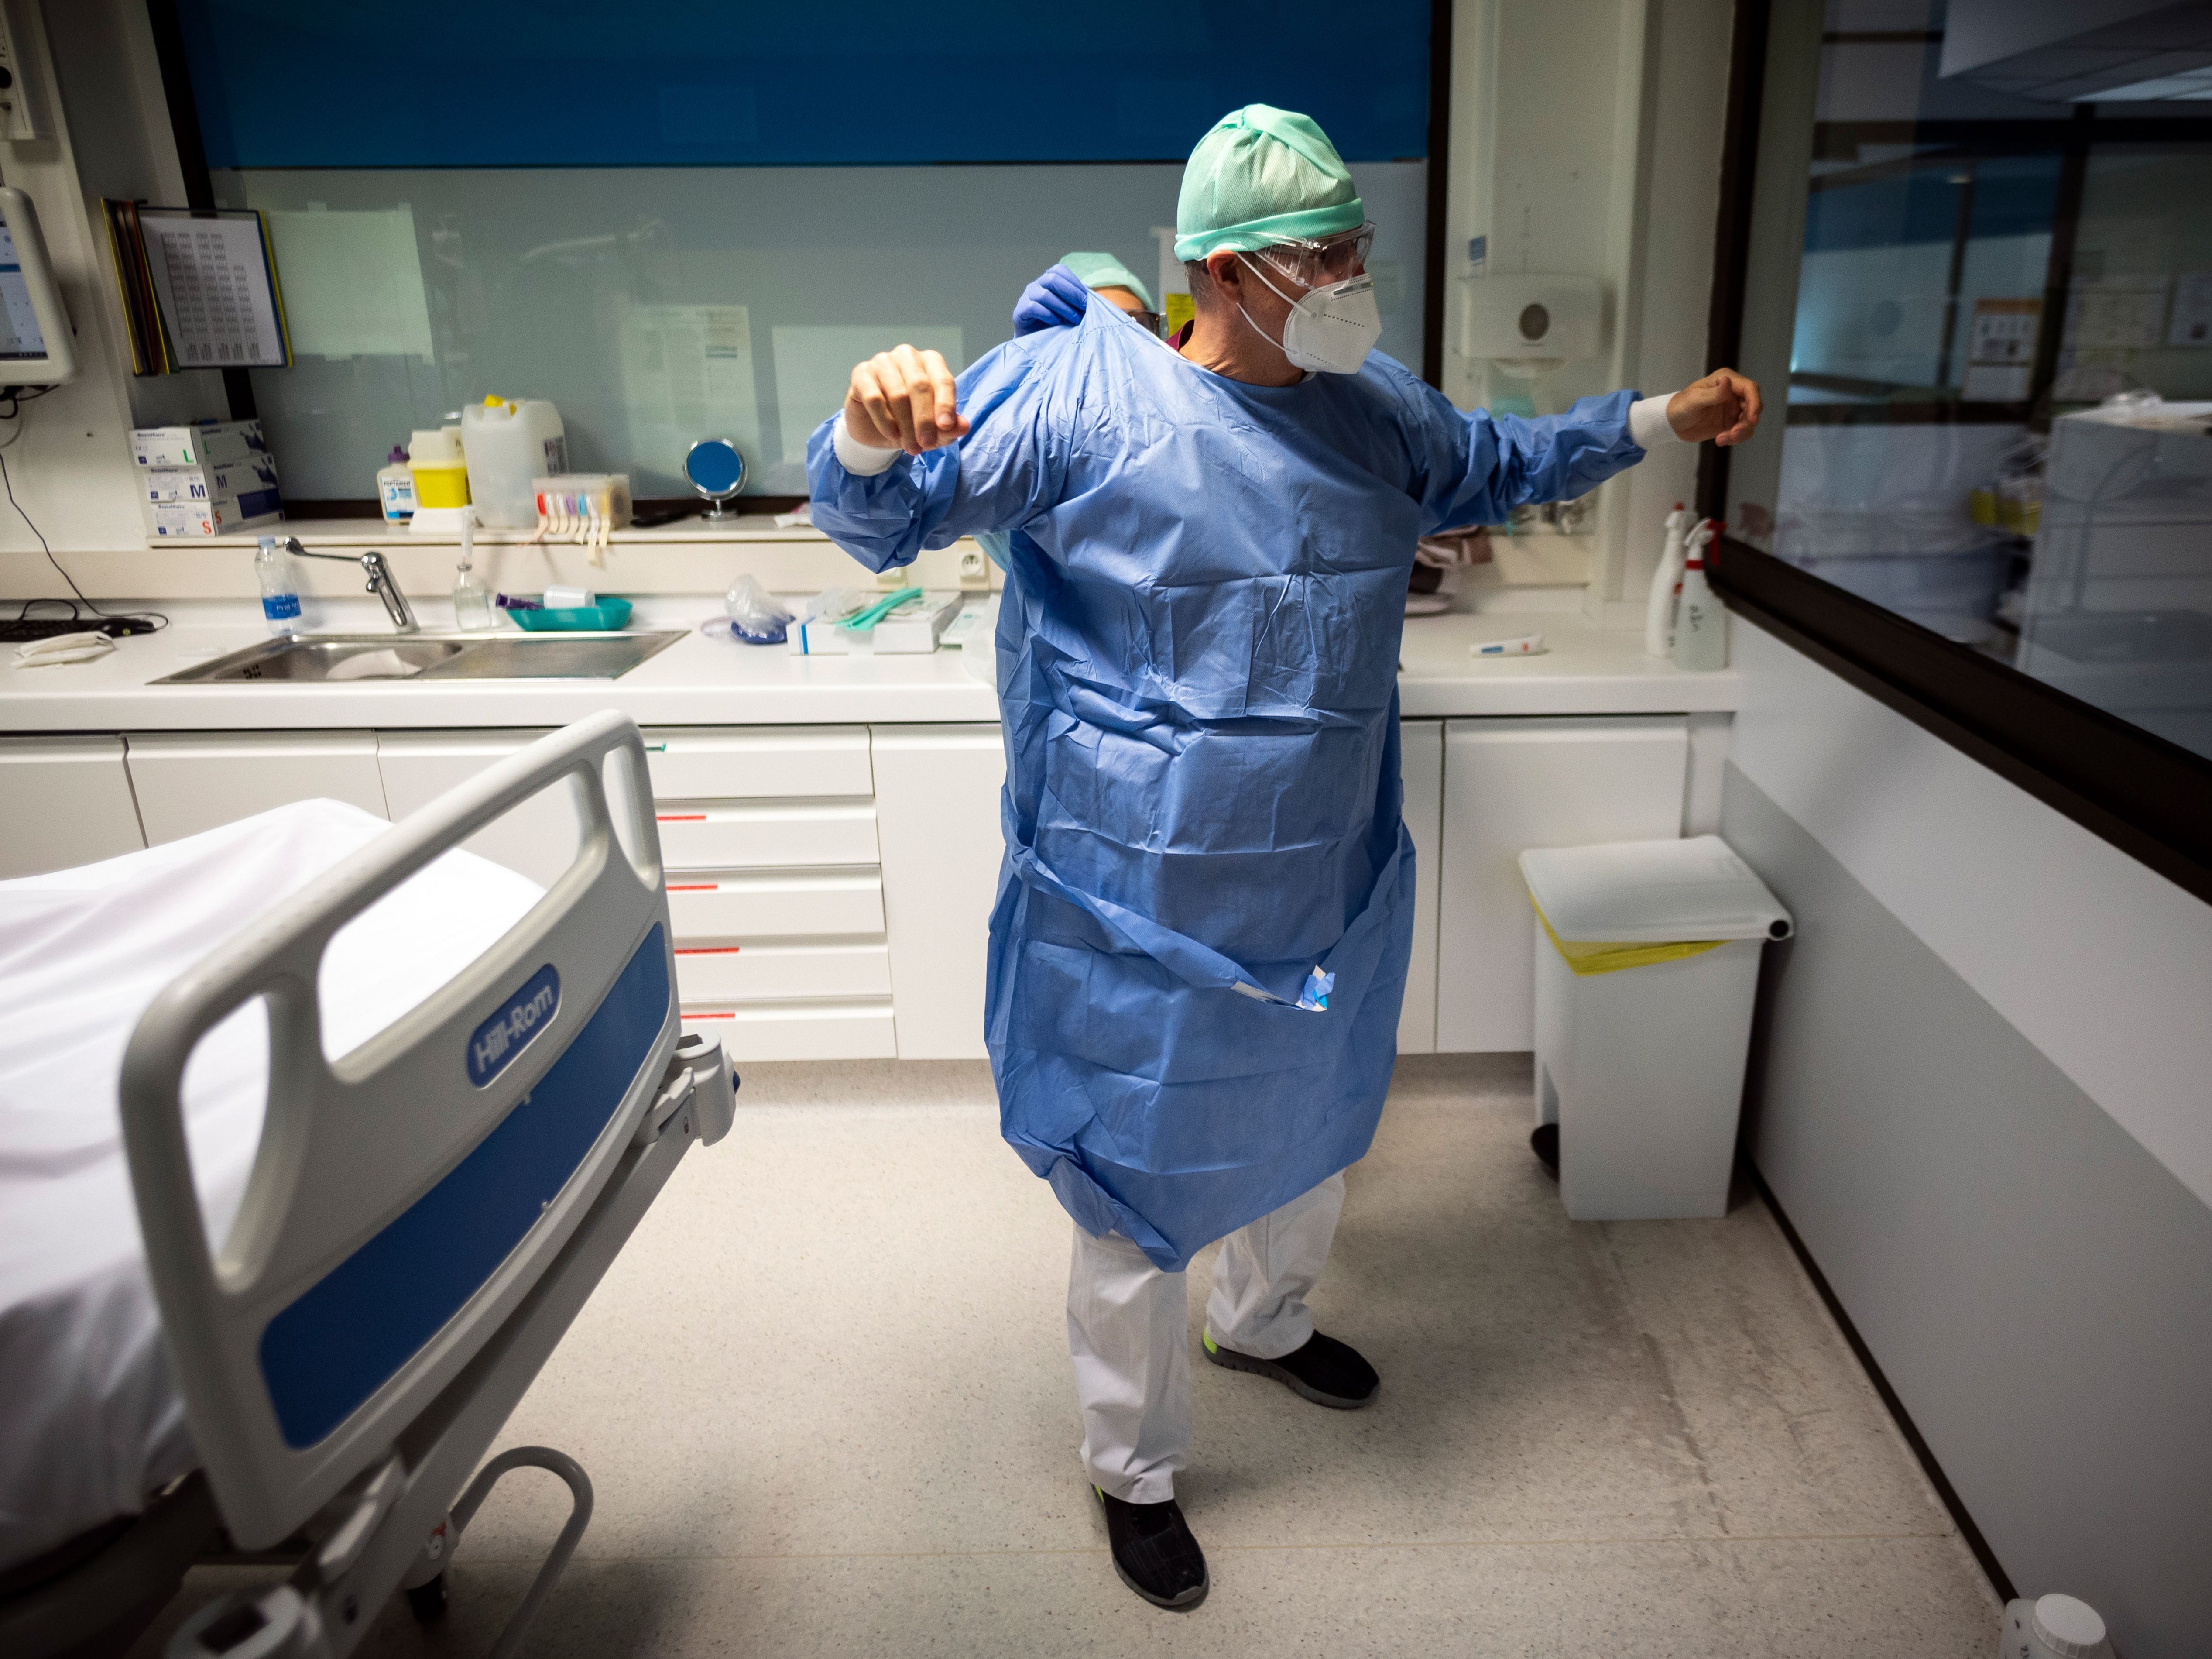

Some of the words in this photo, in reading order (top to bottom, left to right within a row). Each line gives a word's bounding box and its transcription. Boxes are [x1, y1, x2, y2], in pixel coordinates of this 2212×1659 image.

[183, 448, 194, 463] L
[216, 475, 227, 489] M
[190, 484, 206, 498] M
[215, 510, 222, 525] S
[202, 520, 212, 535] S
[474, 986, 553, 1072] Hill-Rom
